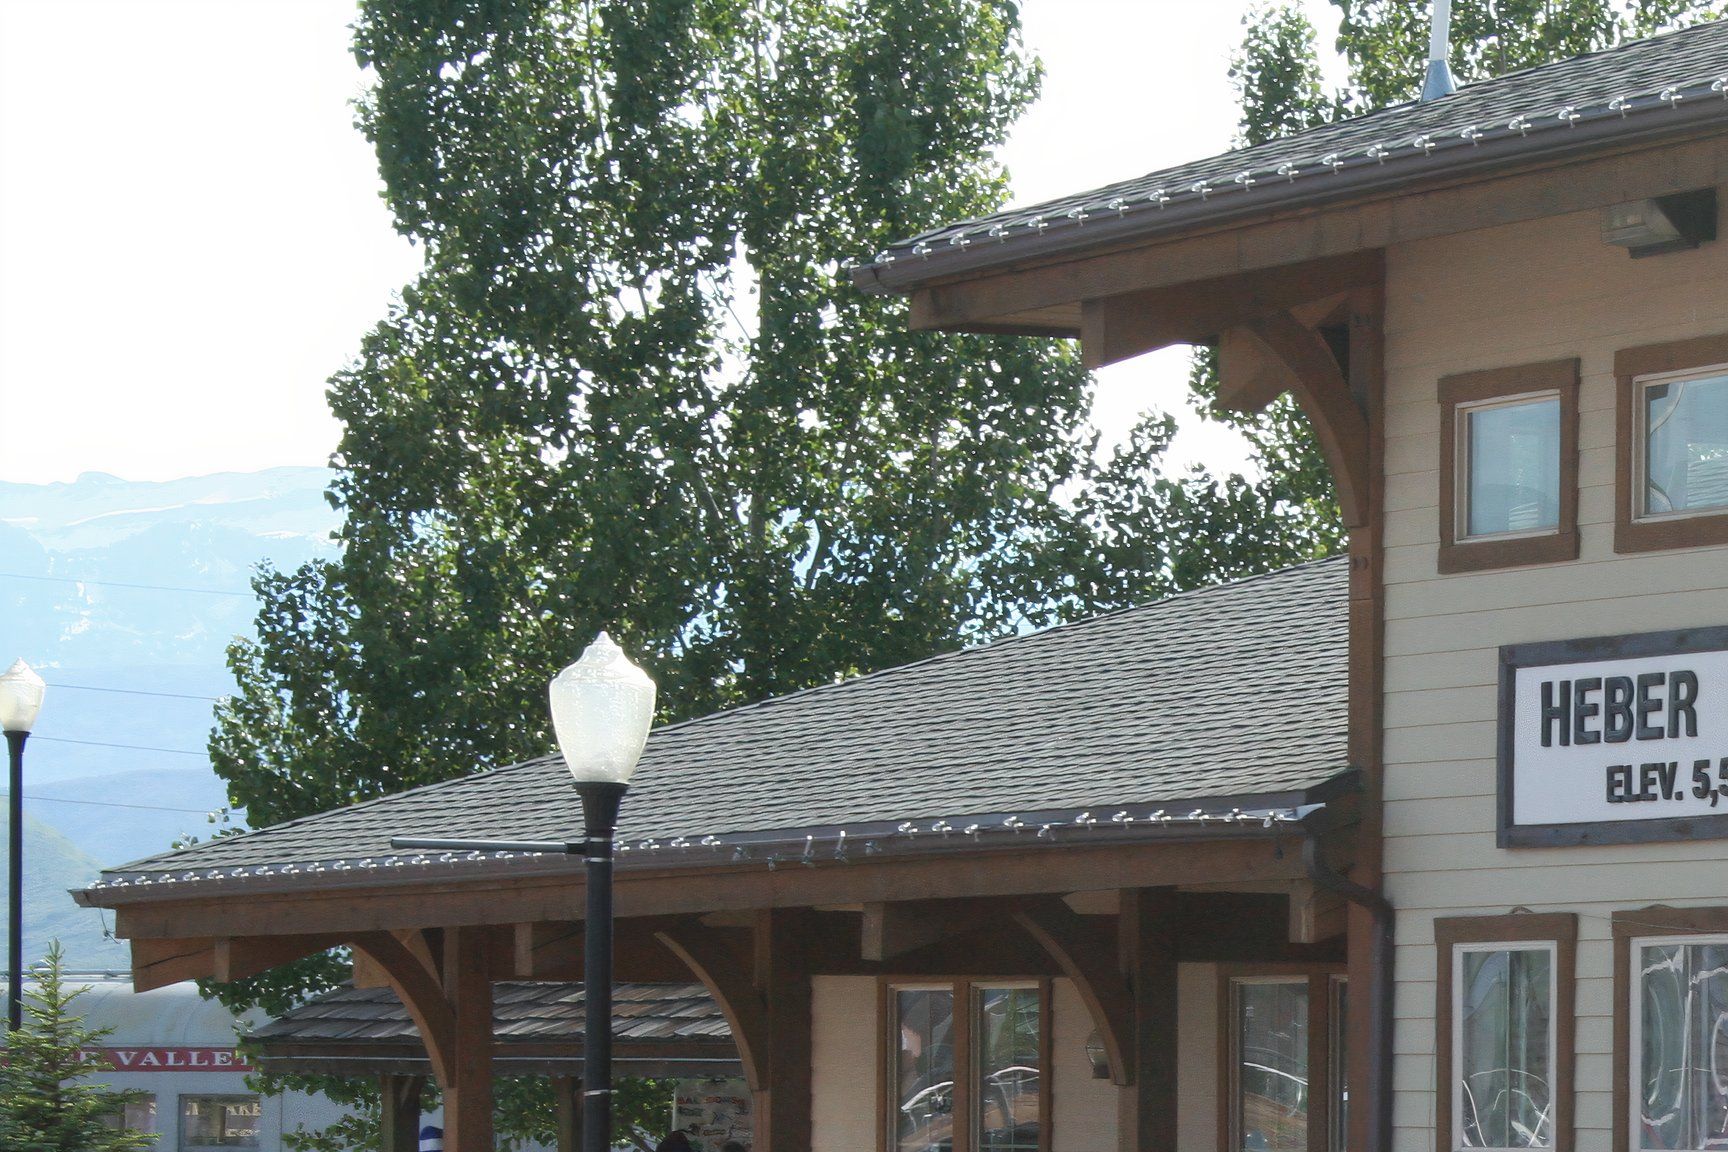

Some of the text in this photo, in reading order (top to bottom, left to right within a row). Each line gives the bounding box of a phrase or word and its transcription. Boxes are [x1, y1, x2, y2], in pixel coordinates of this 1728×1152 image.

[1540, 669, 1699, 748] HEBER
[1606, 761, 1684, 803] ELEV.
[115, 1050, 249, 1067] VALLE
